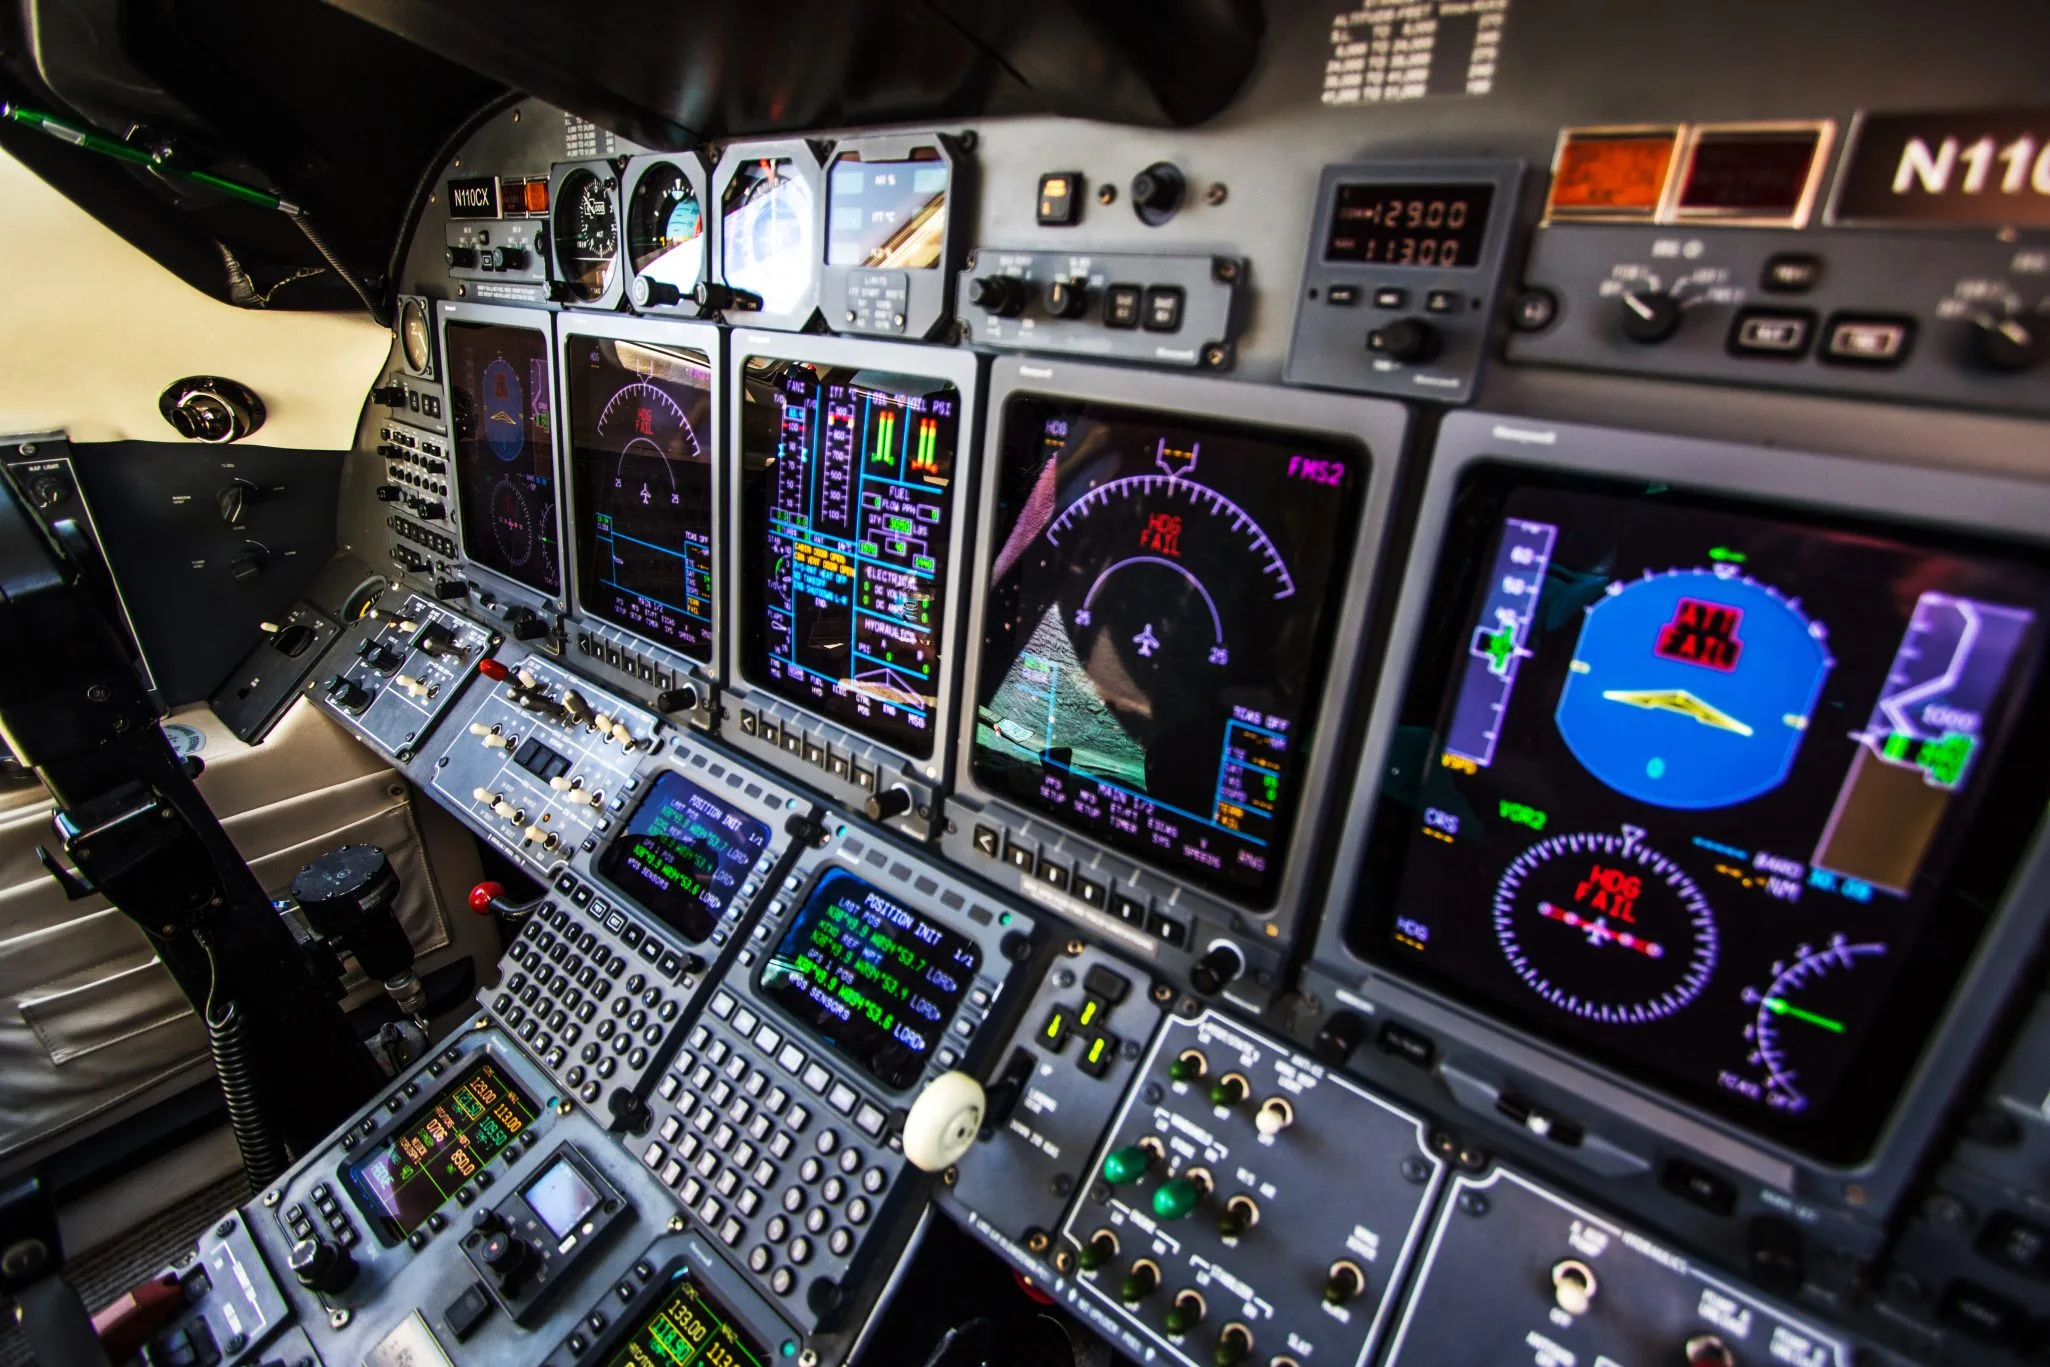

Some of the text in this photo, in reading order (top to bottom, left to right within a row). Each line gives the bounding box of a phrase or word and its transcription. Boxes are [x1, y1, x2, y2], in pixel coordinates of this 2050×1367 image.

[454, 187, 490, 207] N110CX
[1287, 456, 1345, 487] FMS2
[888, 484, 911, 502] FUEL
[1148, 513, 1183, 534] HDG
[1140, 528, 1182, 557] FAIL
[907, 713, 928, 730] MSG
[688, 793, 743, 832] POSITION INIT
[1424, 806, 1460, 834] CRS
[1499, 798, 1549, 831] VOR2
[748, 832, 764, 848] 1/1
[640, 866, 669, 891] SENSORS
[1590, 863, 1643, 901] HDG
[698, 889, 721, 908] LOAD
[838, 896, 881, 928] LAST POS
[1573, 880, 1638, 925] FAIL
[865, 892, 944, 946] POSITION INIT
[807, 948, 825, 966] GPS
[835, 965, 855, 985] POS
[953, 947, 974, 969] 1/1
[926, 965, 953, 991] LOAD
[809, 985, 851, 1022] SENSORS
[909, 993, 937, 1020] LOAD
[893, 1021, 923, 1050] LOAD
[456, 1088, 483, 1117] 121.50
[468, 1076, 497, 1105] 129.00
[425, 1118, 448, 1143] 0706
[478, 1115, 508, 1146] 109.50
[493, 1103, 522, 1133] 113.00
[450, 1148, 476, 1177] 850.0
[668, 1299, 708, 1343] 133.00
[652, 1316, 690, 1361] 118.90
